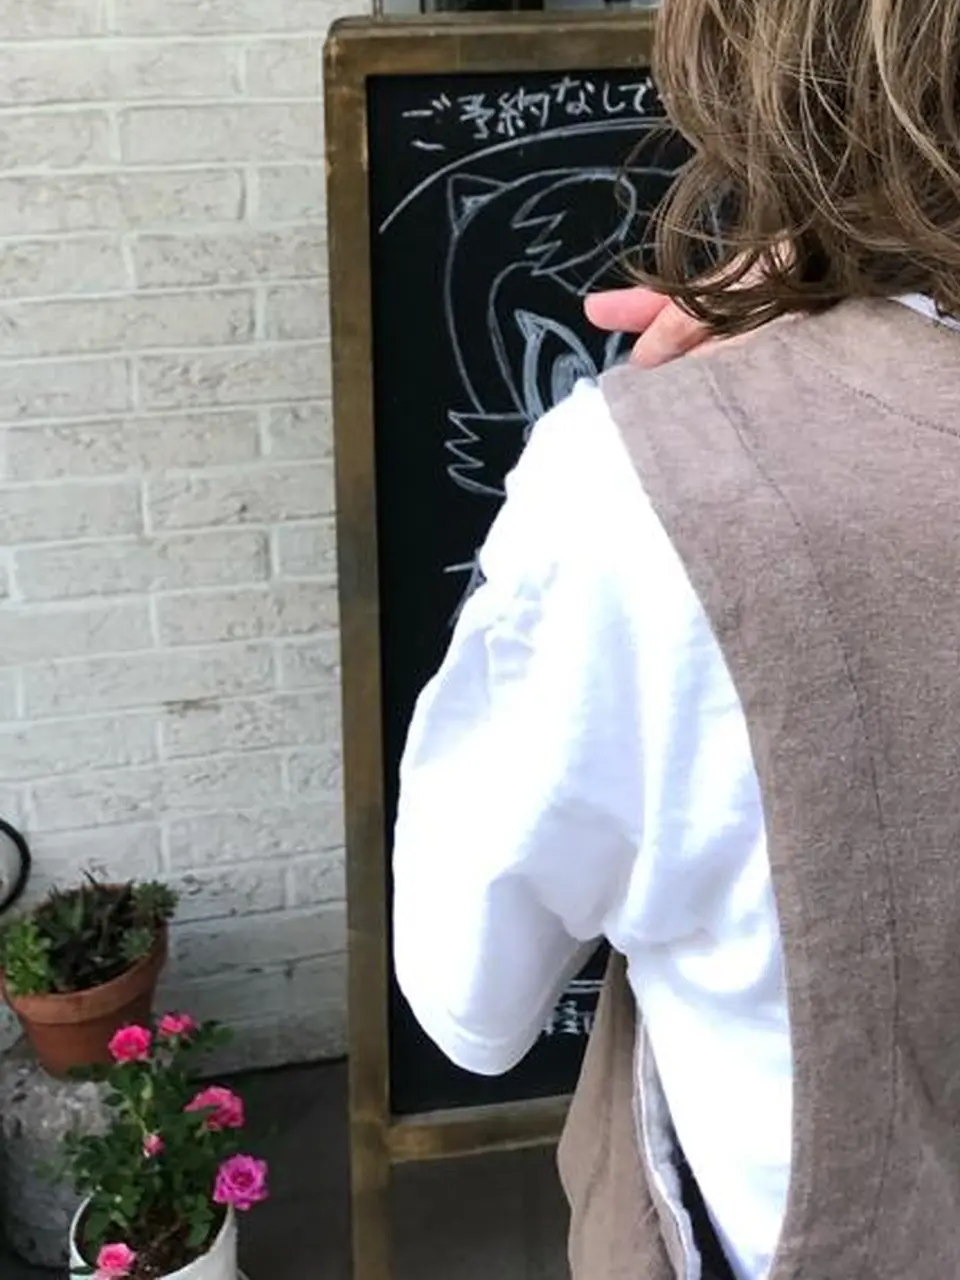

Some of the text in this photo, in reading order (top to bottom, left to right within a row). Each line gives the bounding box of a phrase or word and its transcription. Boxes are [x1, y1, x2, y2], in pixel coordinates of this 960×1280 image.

[402, 75, 665, 151] ご予約なしで
